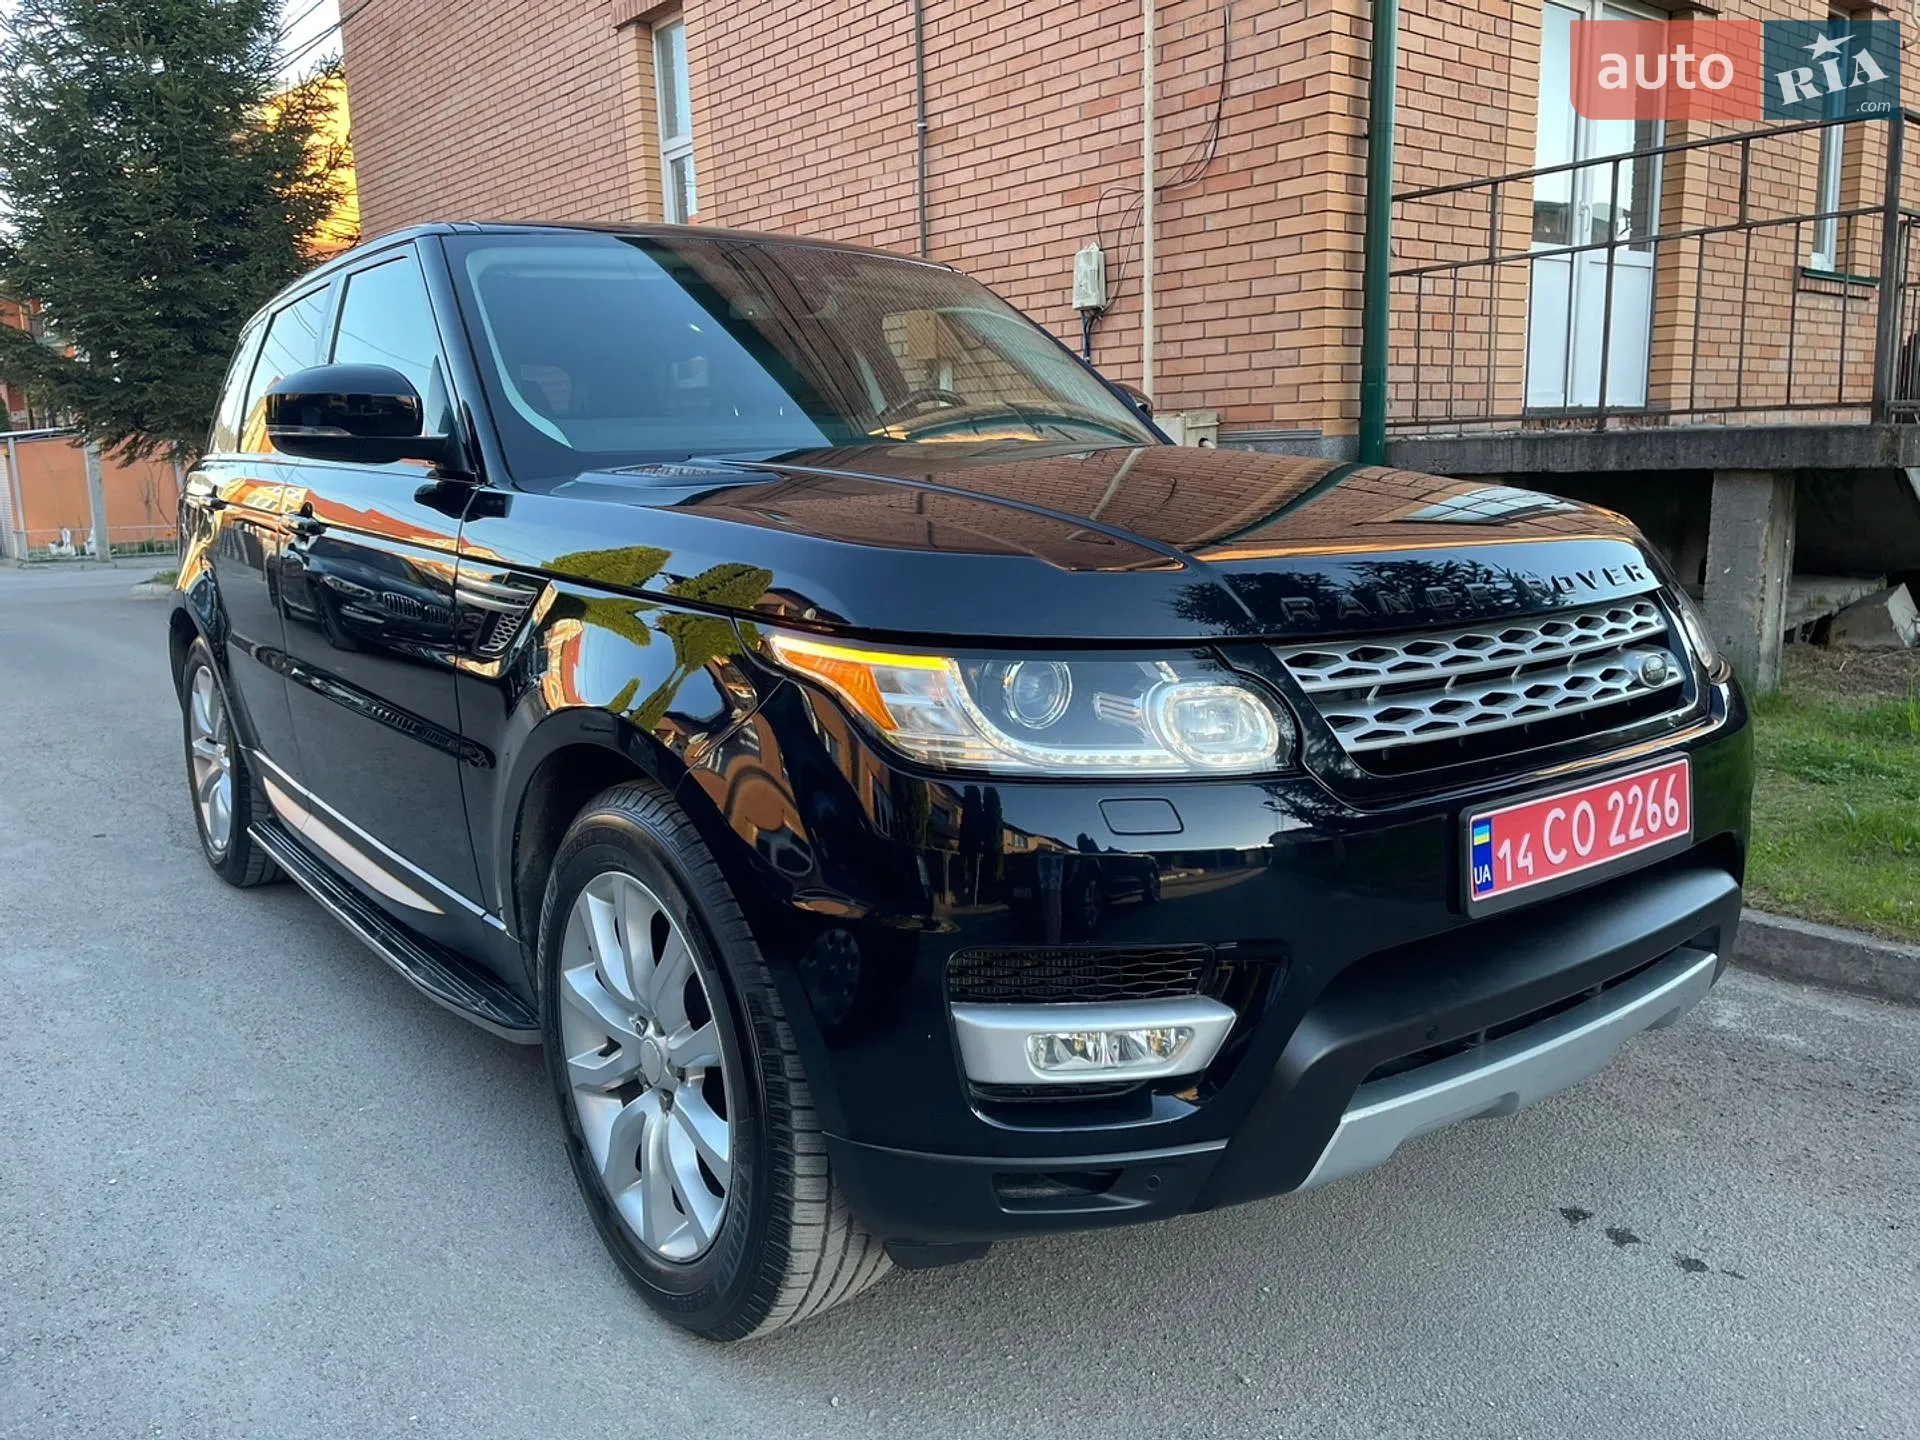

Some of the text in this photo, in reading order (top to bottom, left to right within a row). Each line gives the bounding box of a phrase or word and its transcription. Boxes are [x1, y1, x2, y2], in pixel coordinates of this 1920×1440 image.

[1281, 582, 1497, 622] RANGE
[1497, 772, 1680, 881] 14 CO 2266
[1474, 866, 1491, 885] UA
